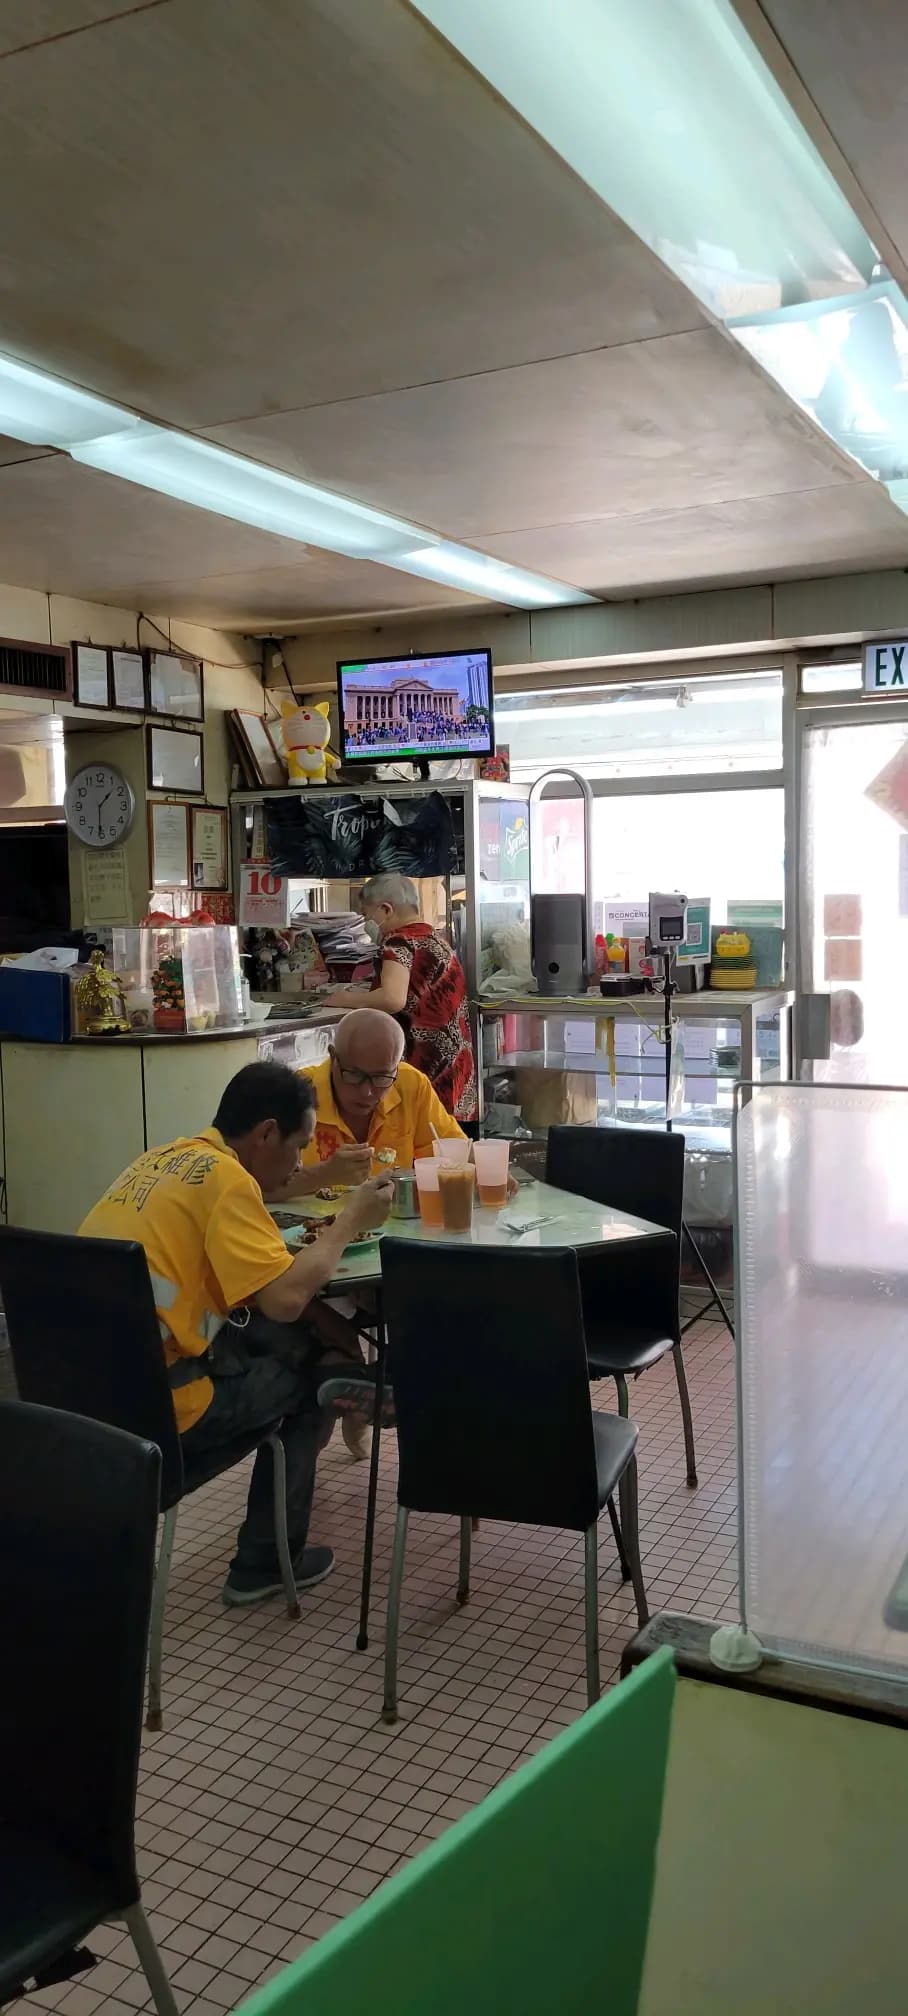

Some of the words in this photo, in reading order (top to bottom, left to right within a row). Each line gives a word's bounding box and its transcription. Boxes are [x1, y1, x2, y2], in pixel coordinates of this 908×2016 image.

[875, 646, 906, 687] EX
[86, 776, 93, 786] 11
[95, 772, 105, 783] 12
[78, 787, 88, 798] 10
[117, 786, 124, 797] 2
[75, 801, 83, 812] 9
[120, 801, 128, 811] 3
[79, 815, 86, 826] 8
[117, 815, 124, 824] 4
[87, 826, 94, 836] 7
[109, 825, 117, 836] 5
[247, 871, 282, 896] 10
[614, 910, 650, 919] CONCERT
